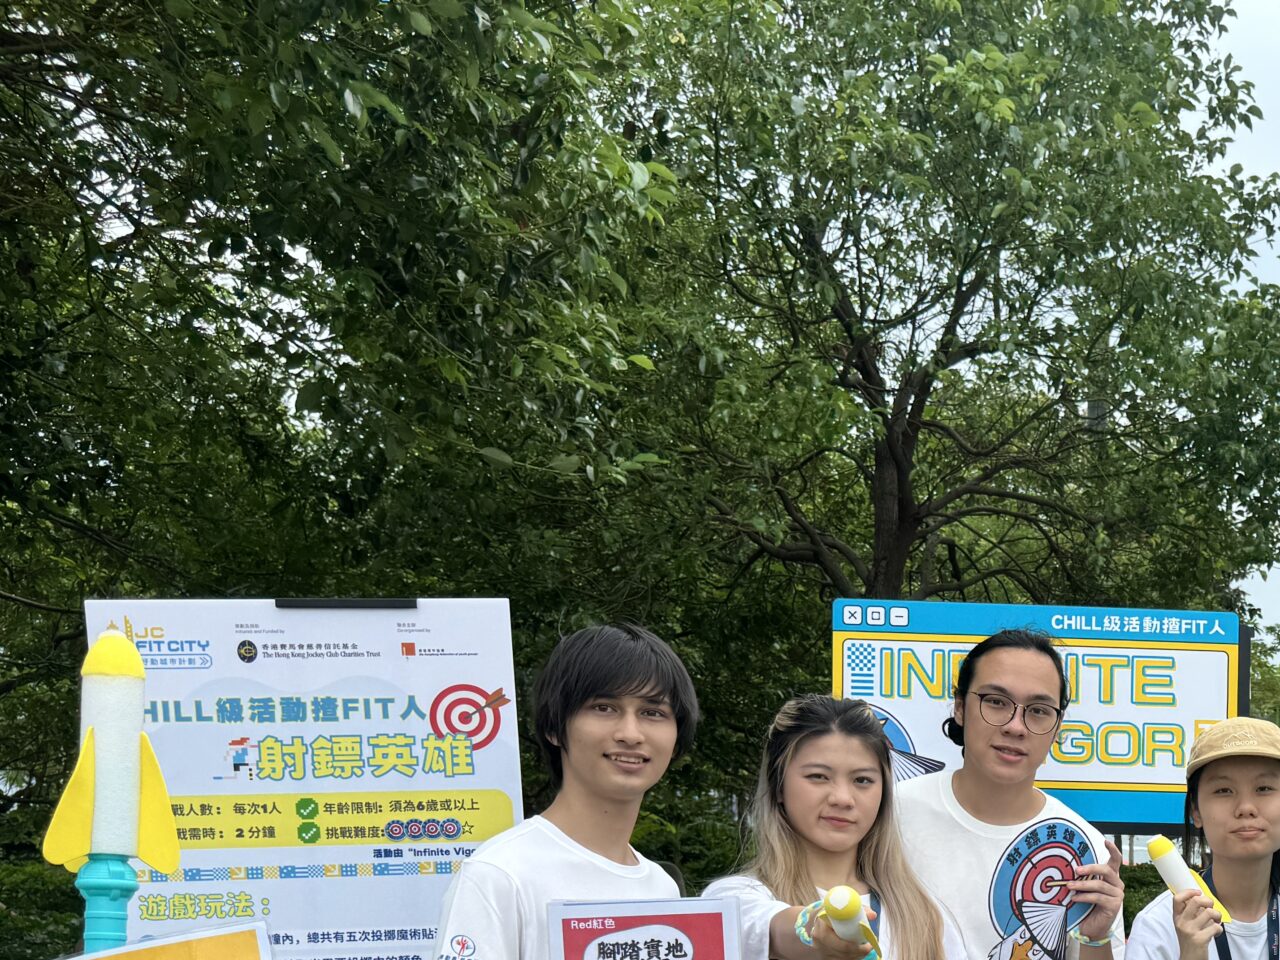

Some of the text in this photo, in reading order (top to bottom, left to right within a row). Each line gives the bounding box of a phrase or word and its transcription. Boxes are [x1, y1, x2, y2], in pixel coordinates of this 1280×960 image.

[135, 626, 165, 639] JC
[1051, 614, 1226, 635] CHILL級活動揸FIT人
[136, 640, 210, 652] FIT CITY
[144, 695, 427, 723] HILL級活動揸FIT人
[1048, 719, 1187, 768] GOR
[257, 733, 477, 780] 射鏢英雄
[171, 798, 480, 817] 戰人數： 每次1人 年齡限制: 須為6歲或以上
[177, 827, 224, 841] 戰需時：
[235, 828, 245, 838] 2
[373, 848, 403, 859] 活動由
[138, 891, 271, 921] 遊戲玩法：
[570, 917, 616, 930] Red紅色
[597, 938, 688, 960] 腳踏實地
